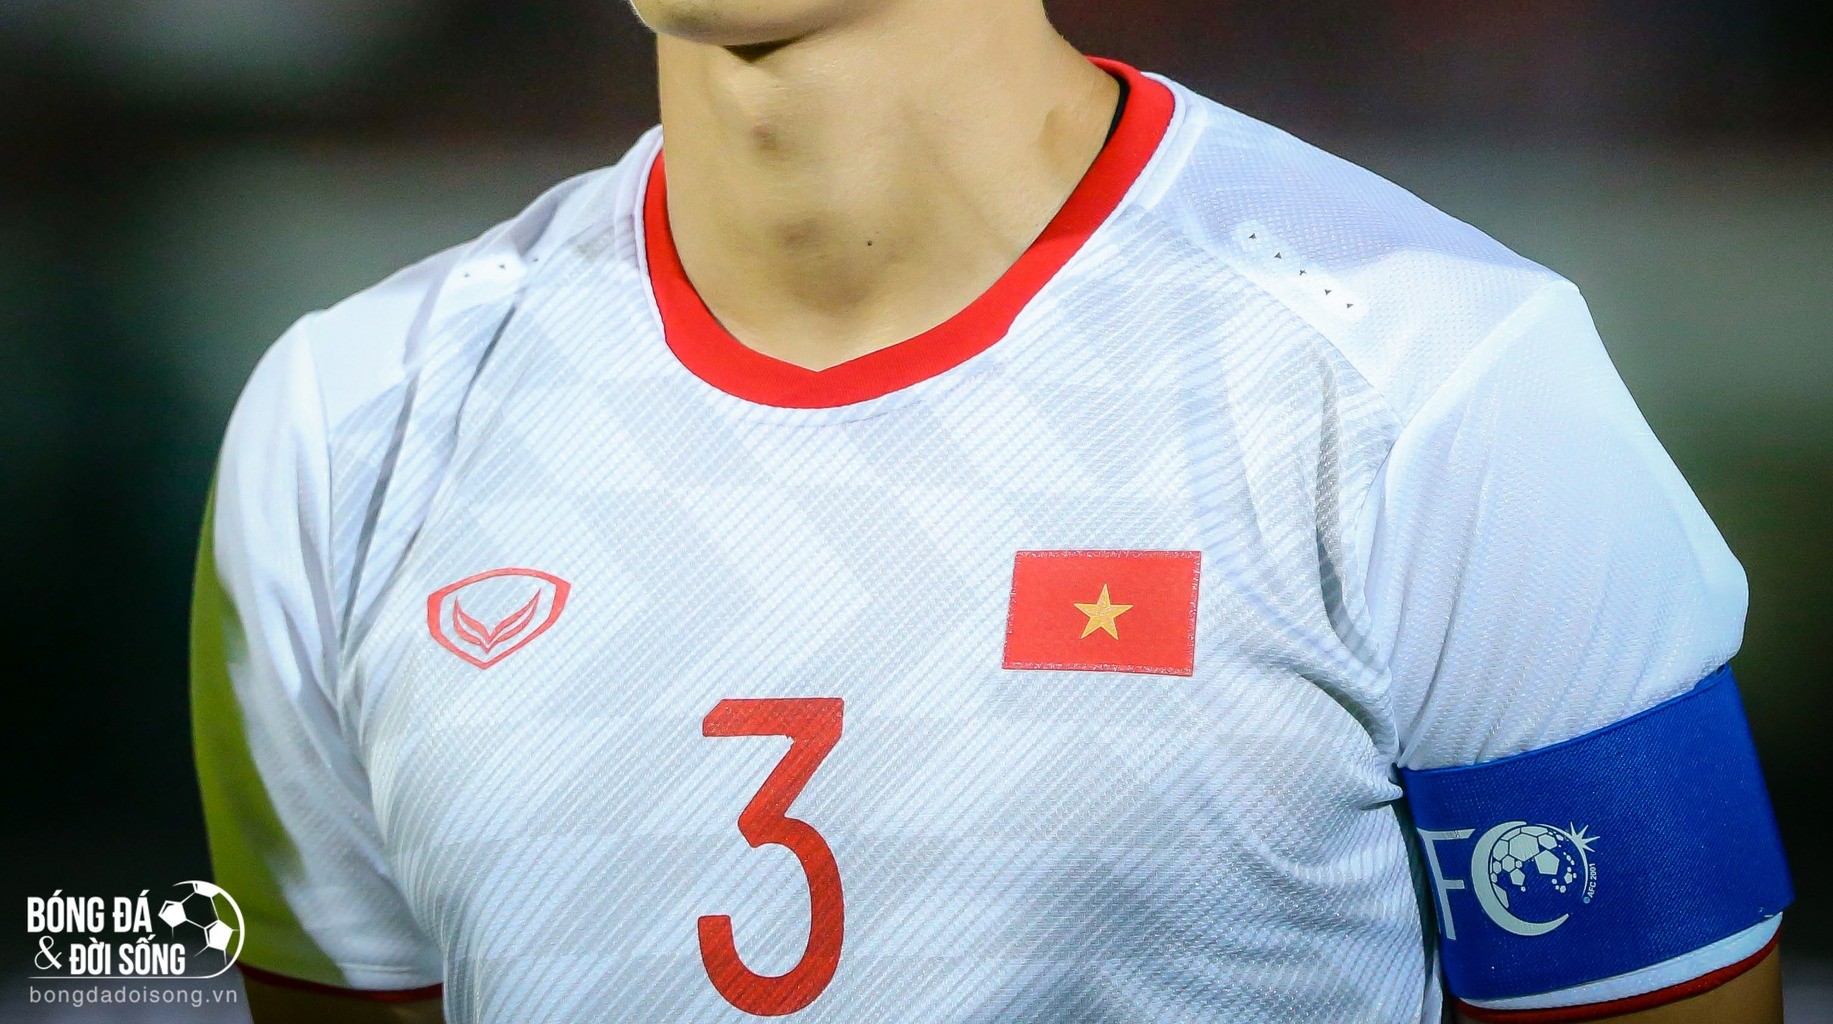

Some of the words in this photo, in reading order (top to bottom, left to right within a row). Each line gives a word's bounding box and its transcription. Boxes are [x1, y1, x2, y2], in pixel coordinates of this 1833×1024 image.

[697, 697, 845, 1017] 3
[1415, 820, 1569, 941] FC
[1588, 863, 1597, 881] 2001
